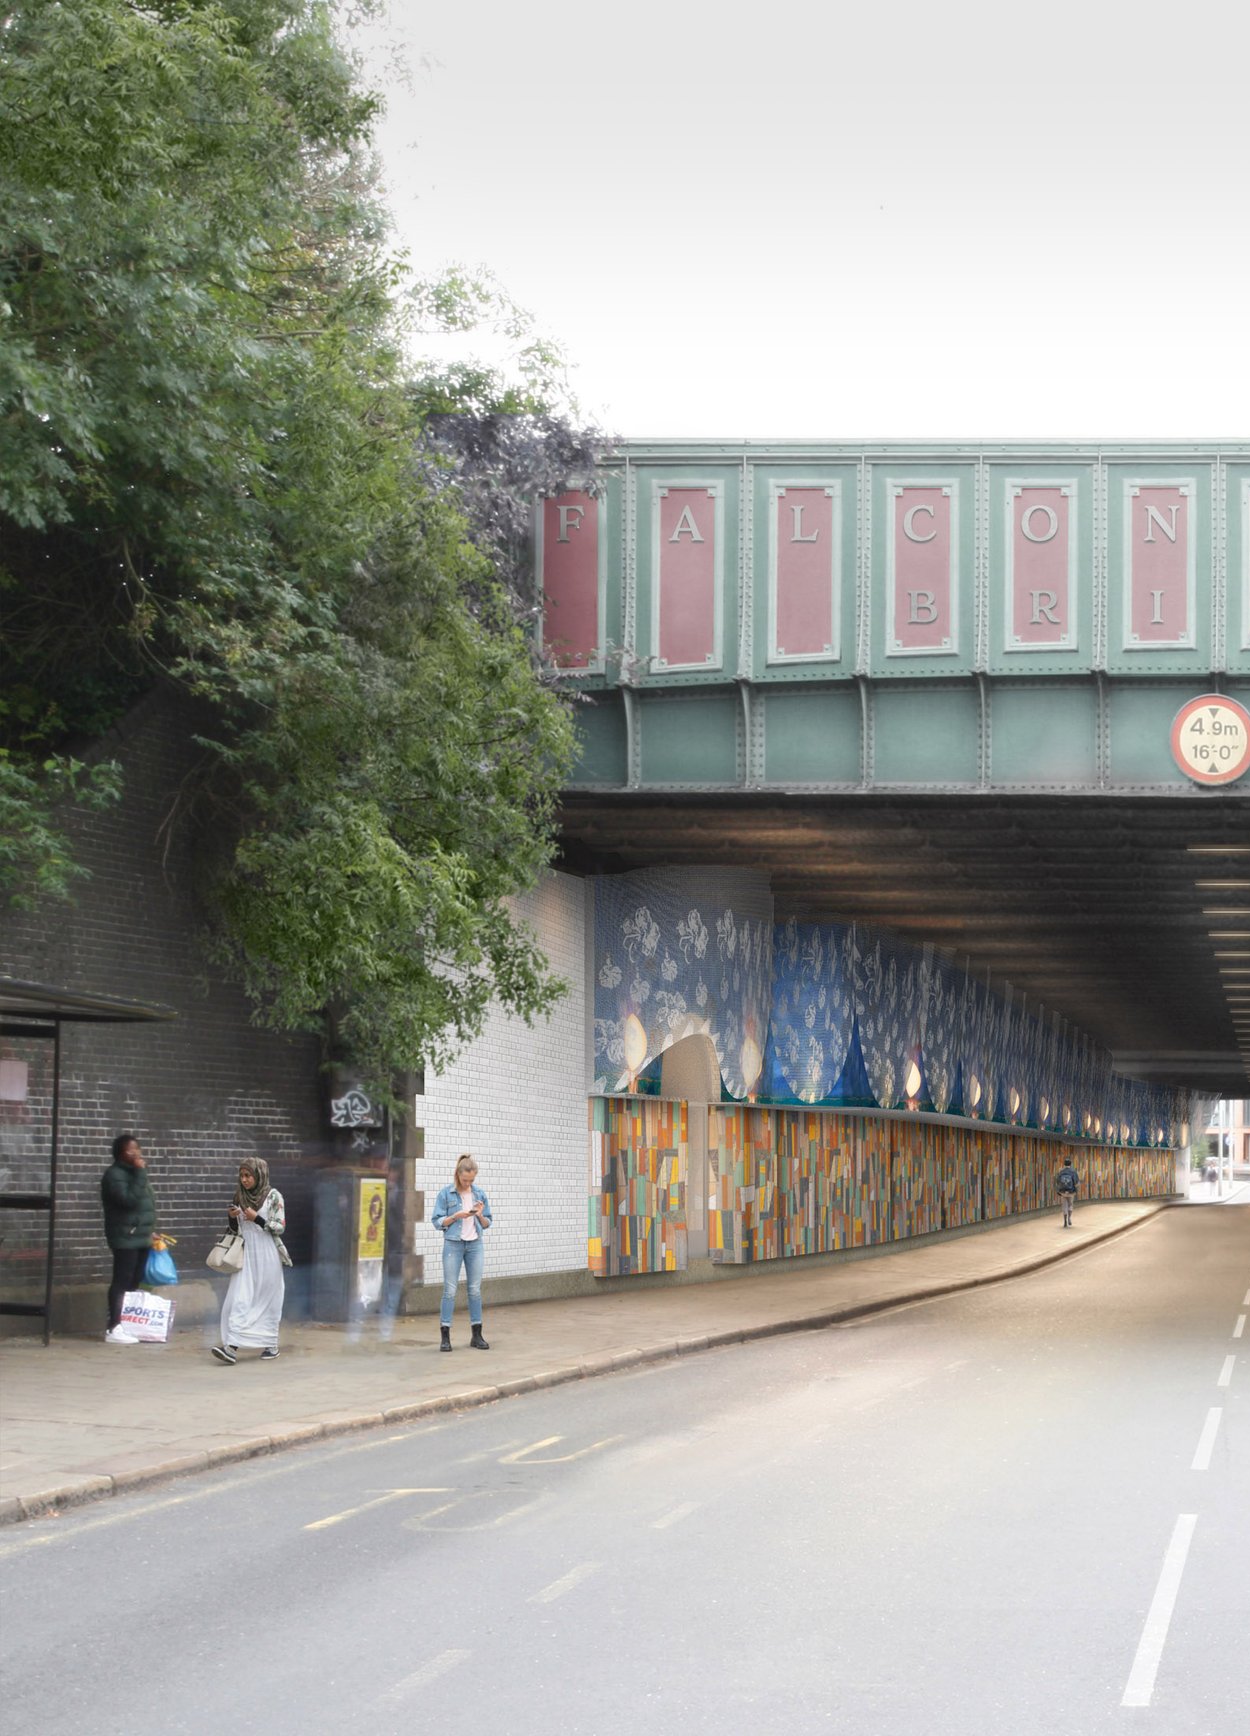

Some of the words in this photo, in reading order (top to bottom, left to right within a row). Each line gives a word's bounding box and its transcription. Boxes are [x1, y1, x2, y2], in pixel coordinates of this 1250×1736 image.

[556, 504, 1180, 543] FALCON
[1190, 717, 1239, 736] 4.9m
[123, 1306, 165, 1319] SPORTS
